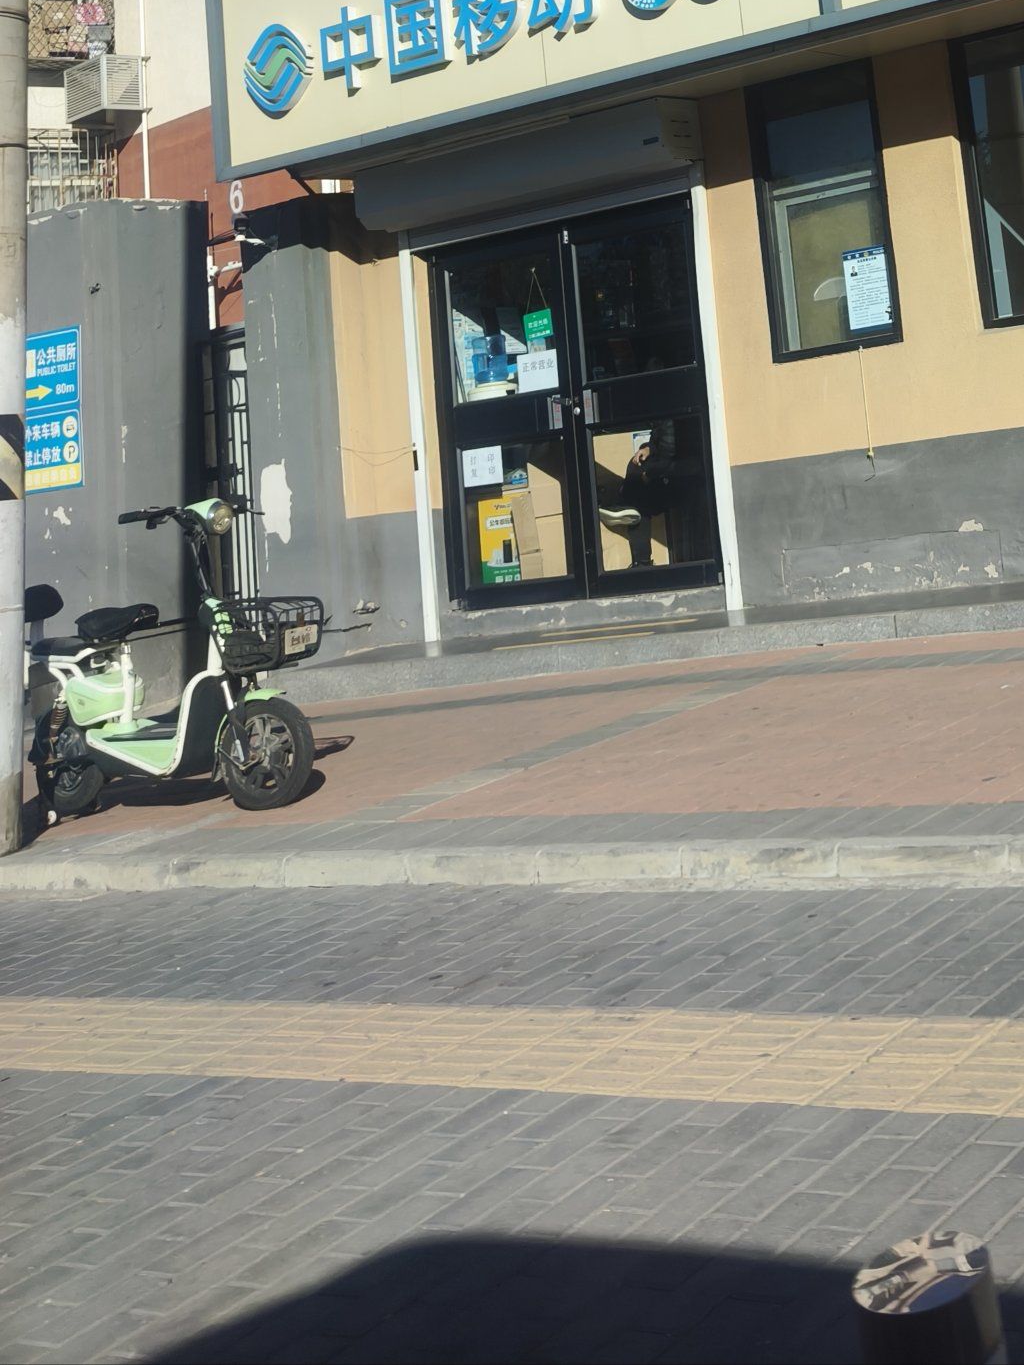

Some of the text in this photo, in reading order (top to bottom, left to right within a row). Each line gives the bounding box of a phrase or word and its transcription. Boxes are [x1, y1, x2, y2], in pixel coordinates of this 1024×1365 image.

[230, 180, 244, 214] 6
[36, 342, 77, 366] 公共厕所
[36, 361, 76, 378] PUBLIC TOILET
[522, 358, 555, 373] 正常营业
[55, 383, 75, 395] 80m
